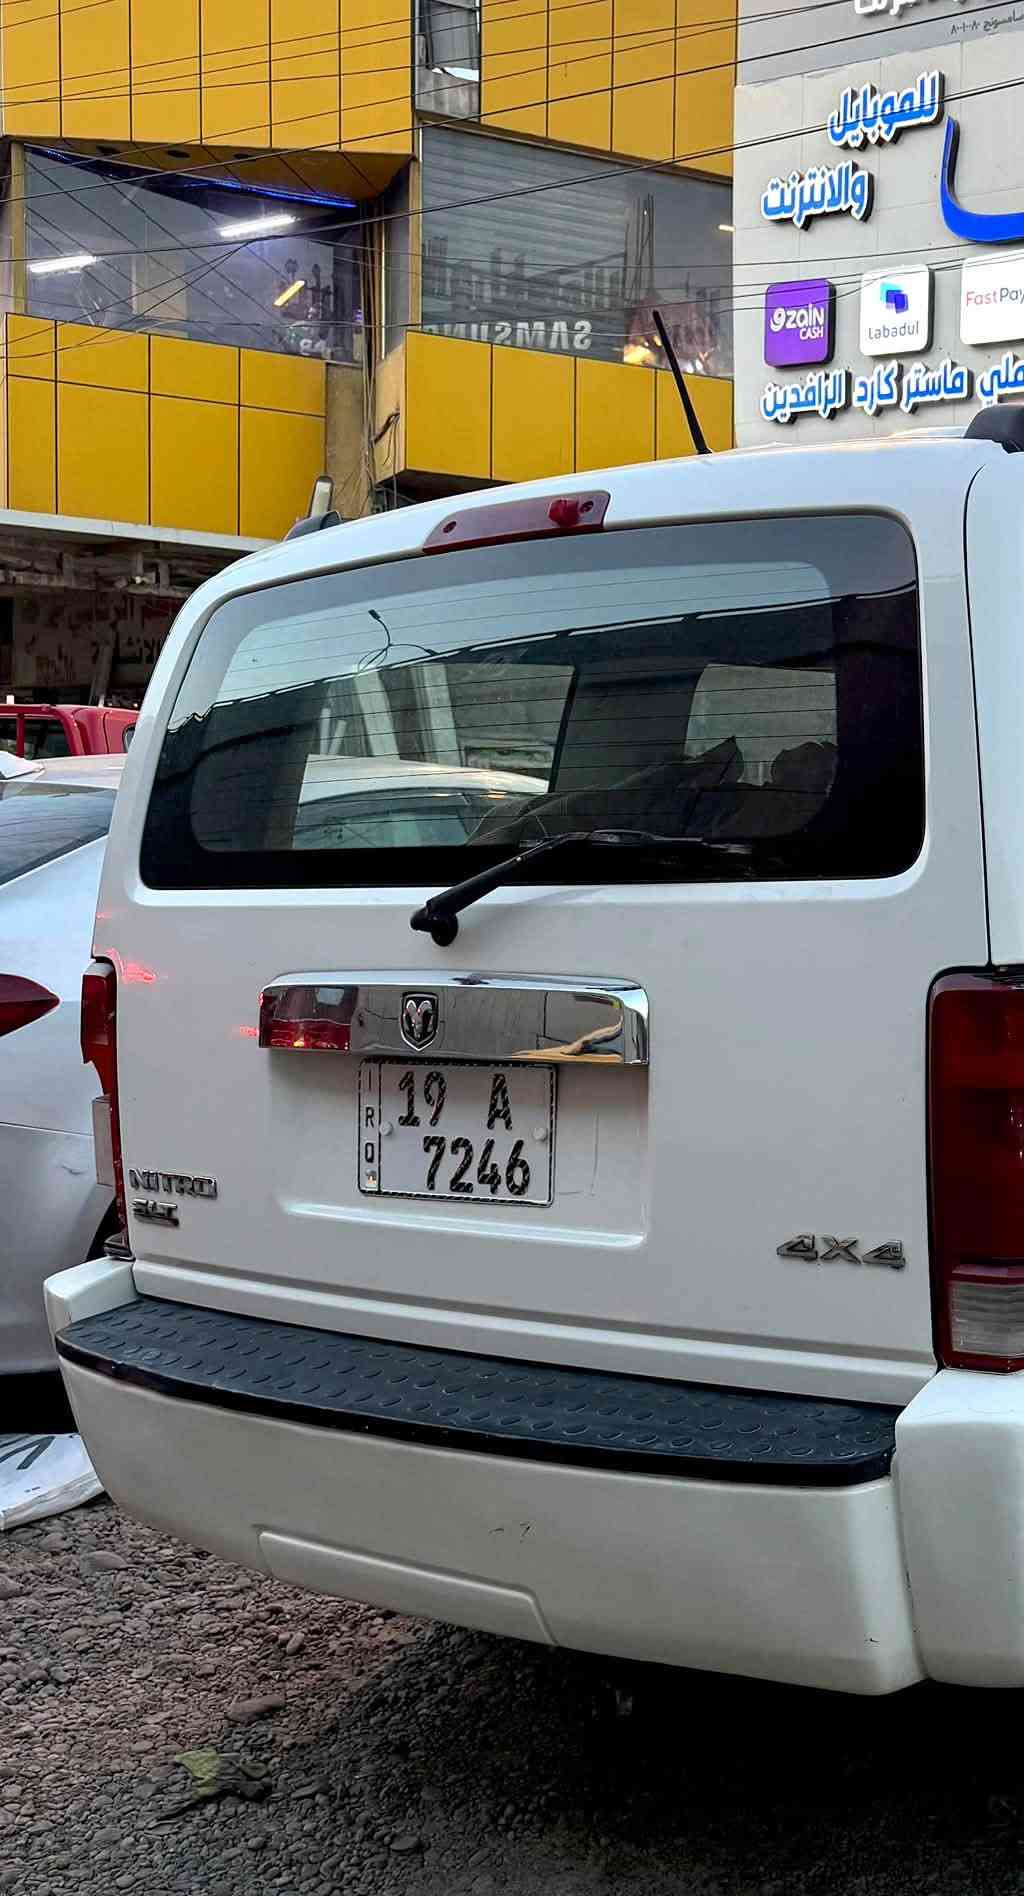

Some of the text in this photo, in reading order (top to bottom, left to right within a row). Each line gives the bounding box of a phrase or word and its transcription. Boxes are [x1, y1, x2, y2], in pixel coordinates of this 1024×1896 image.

[827, 70, 940, 147] للموبايل
[761, 160, 871, 228] والانترنت
[800, 326, 824, 340] CASH
[761, 367, 847, 422] الرافدين
[853, 359, 898, 416] كارد
[900, 358, 969, 413] ماستر
[398, 1070, 513, 1130] 19 A
[129, 1168, 217, 1199] NITRO
[423, 1135, 531, 1197] 7246
